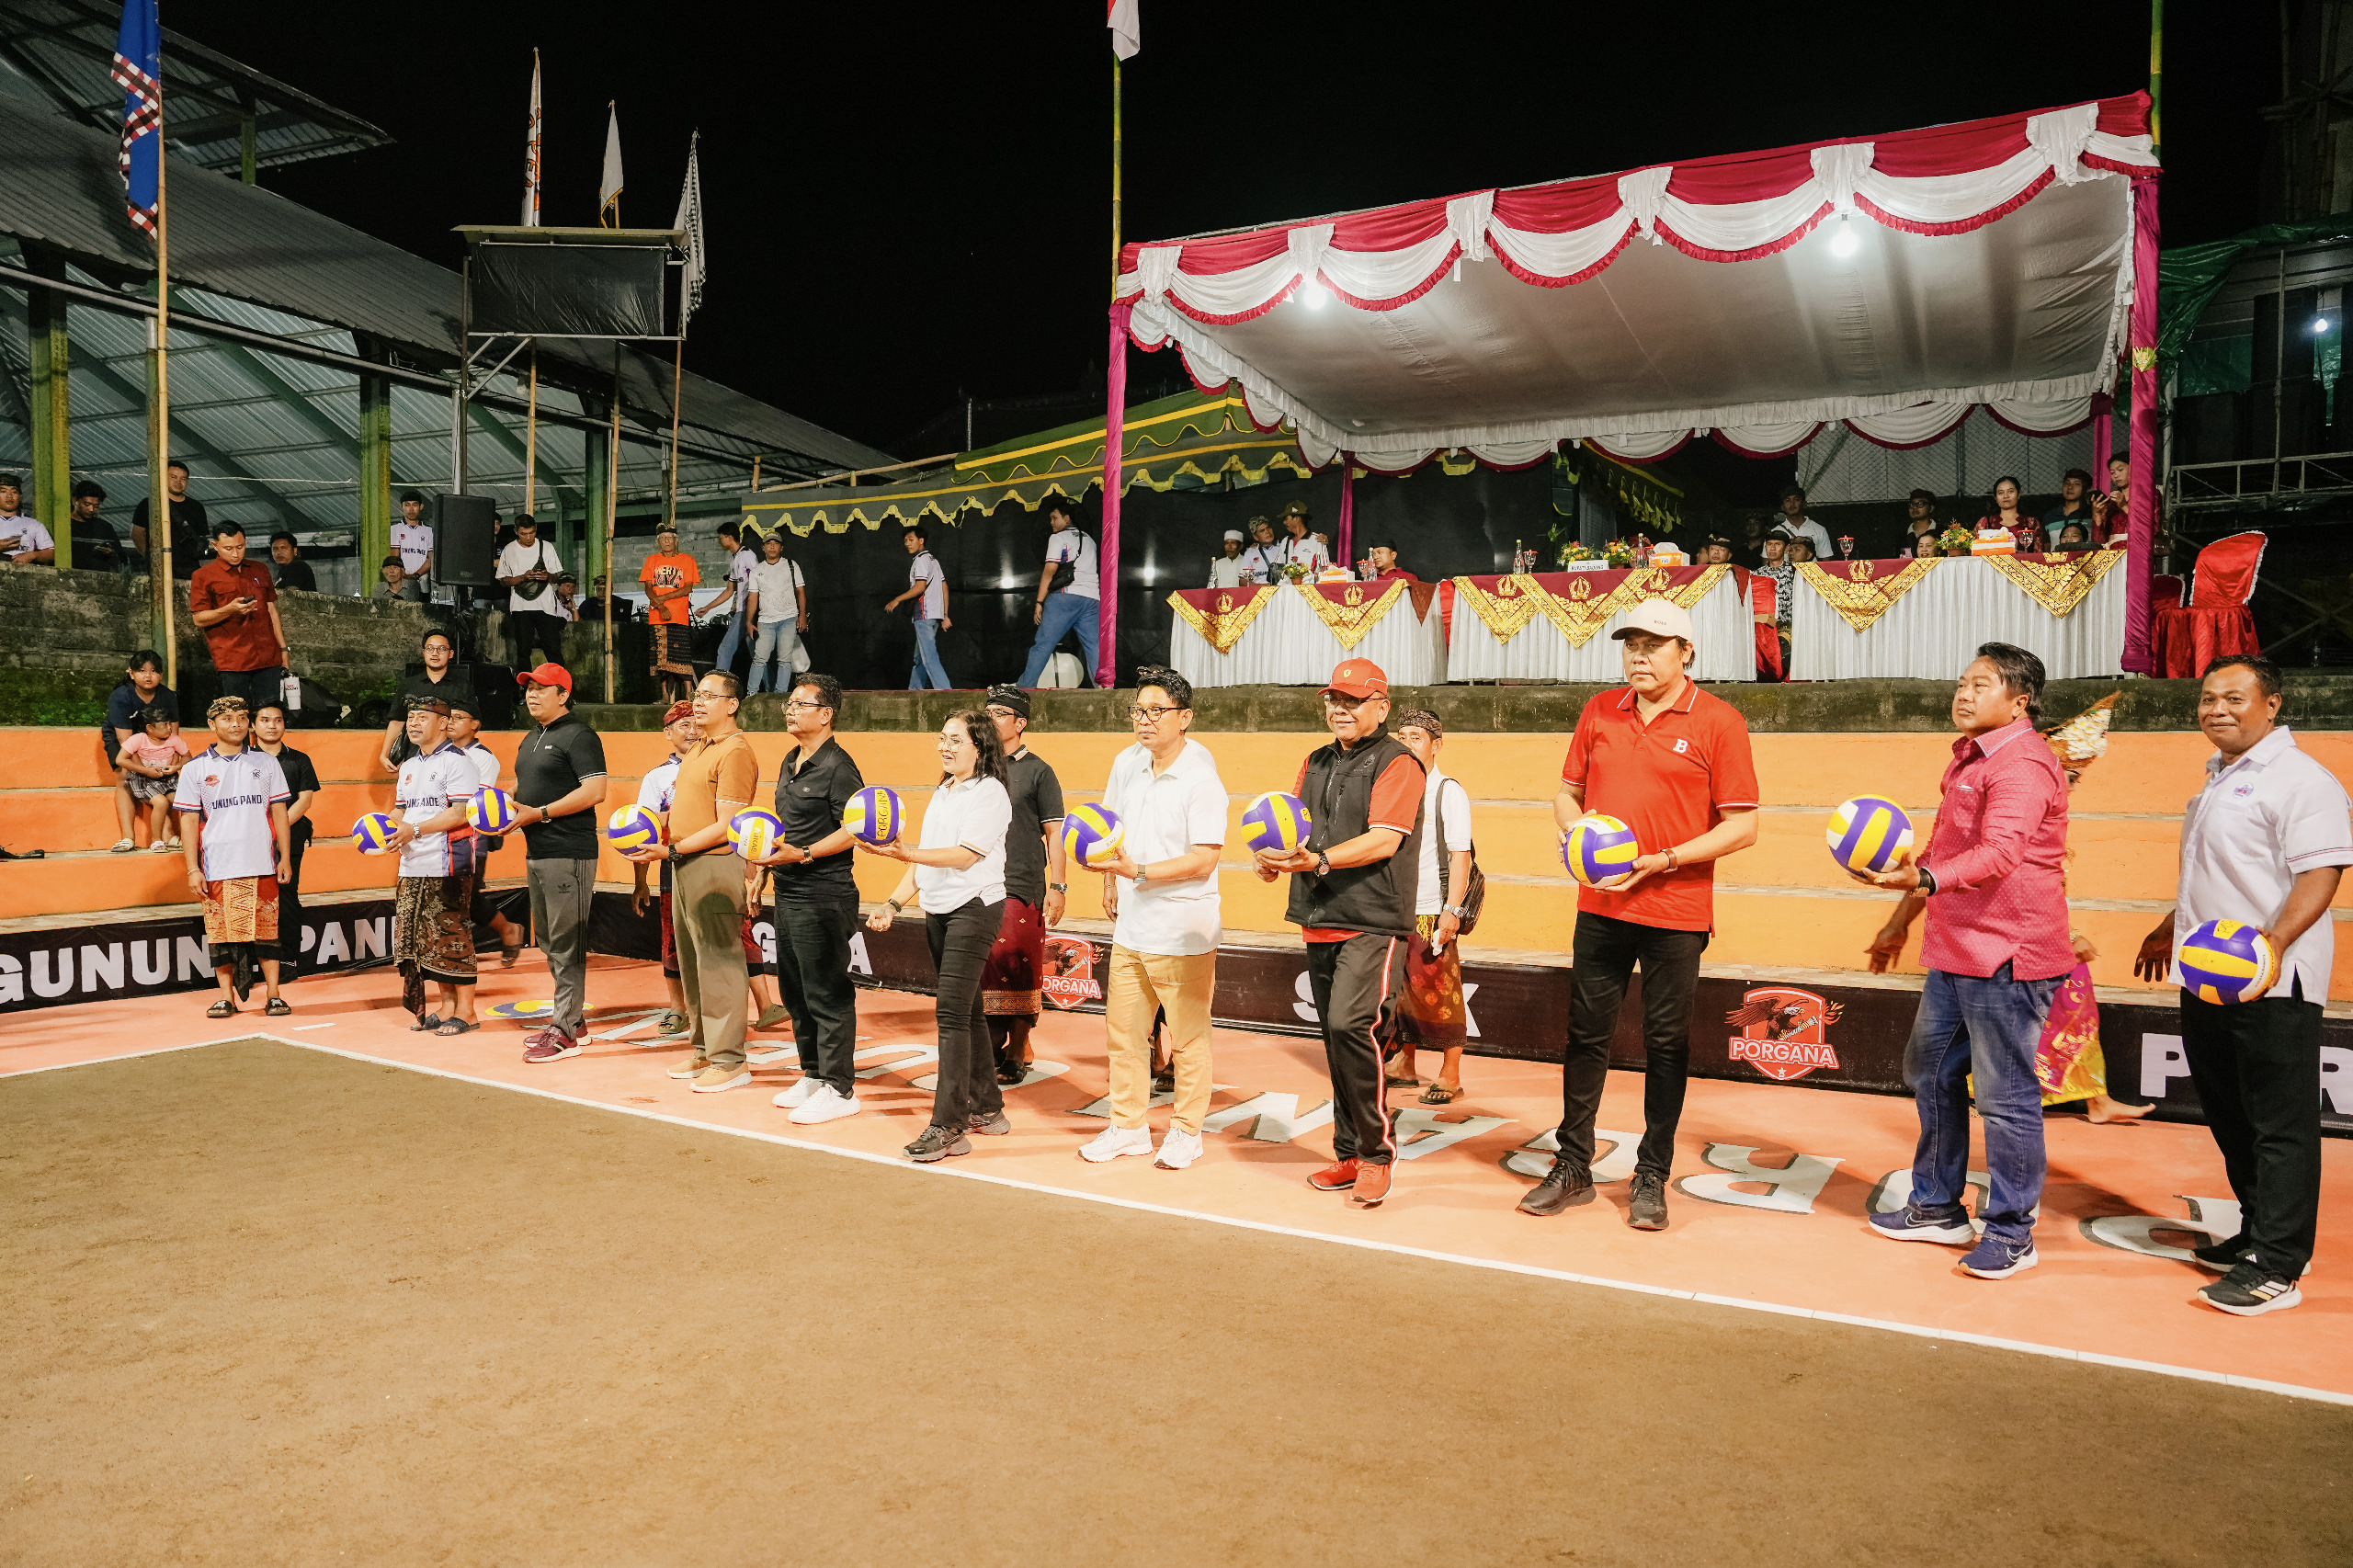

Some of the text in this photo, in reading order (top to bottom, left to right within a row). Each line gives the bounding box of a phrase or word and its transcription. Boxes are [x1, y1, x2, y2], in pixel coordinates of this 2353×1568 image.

[211, 794, 262, 810] UNUNG PAND
[1041, 977, 1099, 997] ORGANA
[1732, 1040, 1835, 1065] PORGANA
